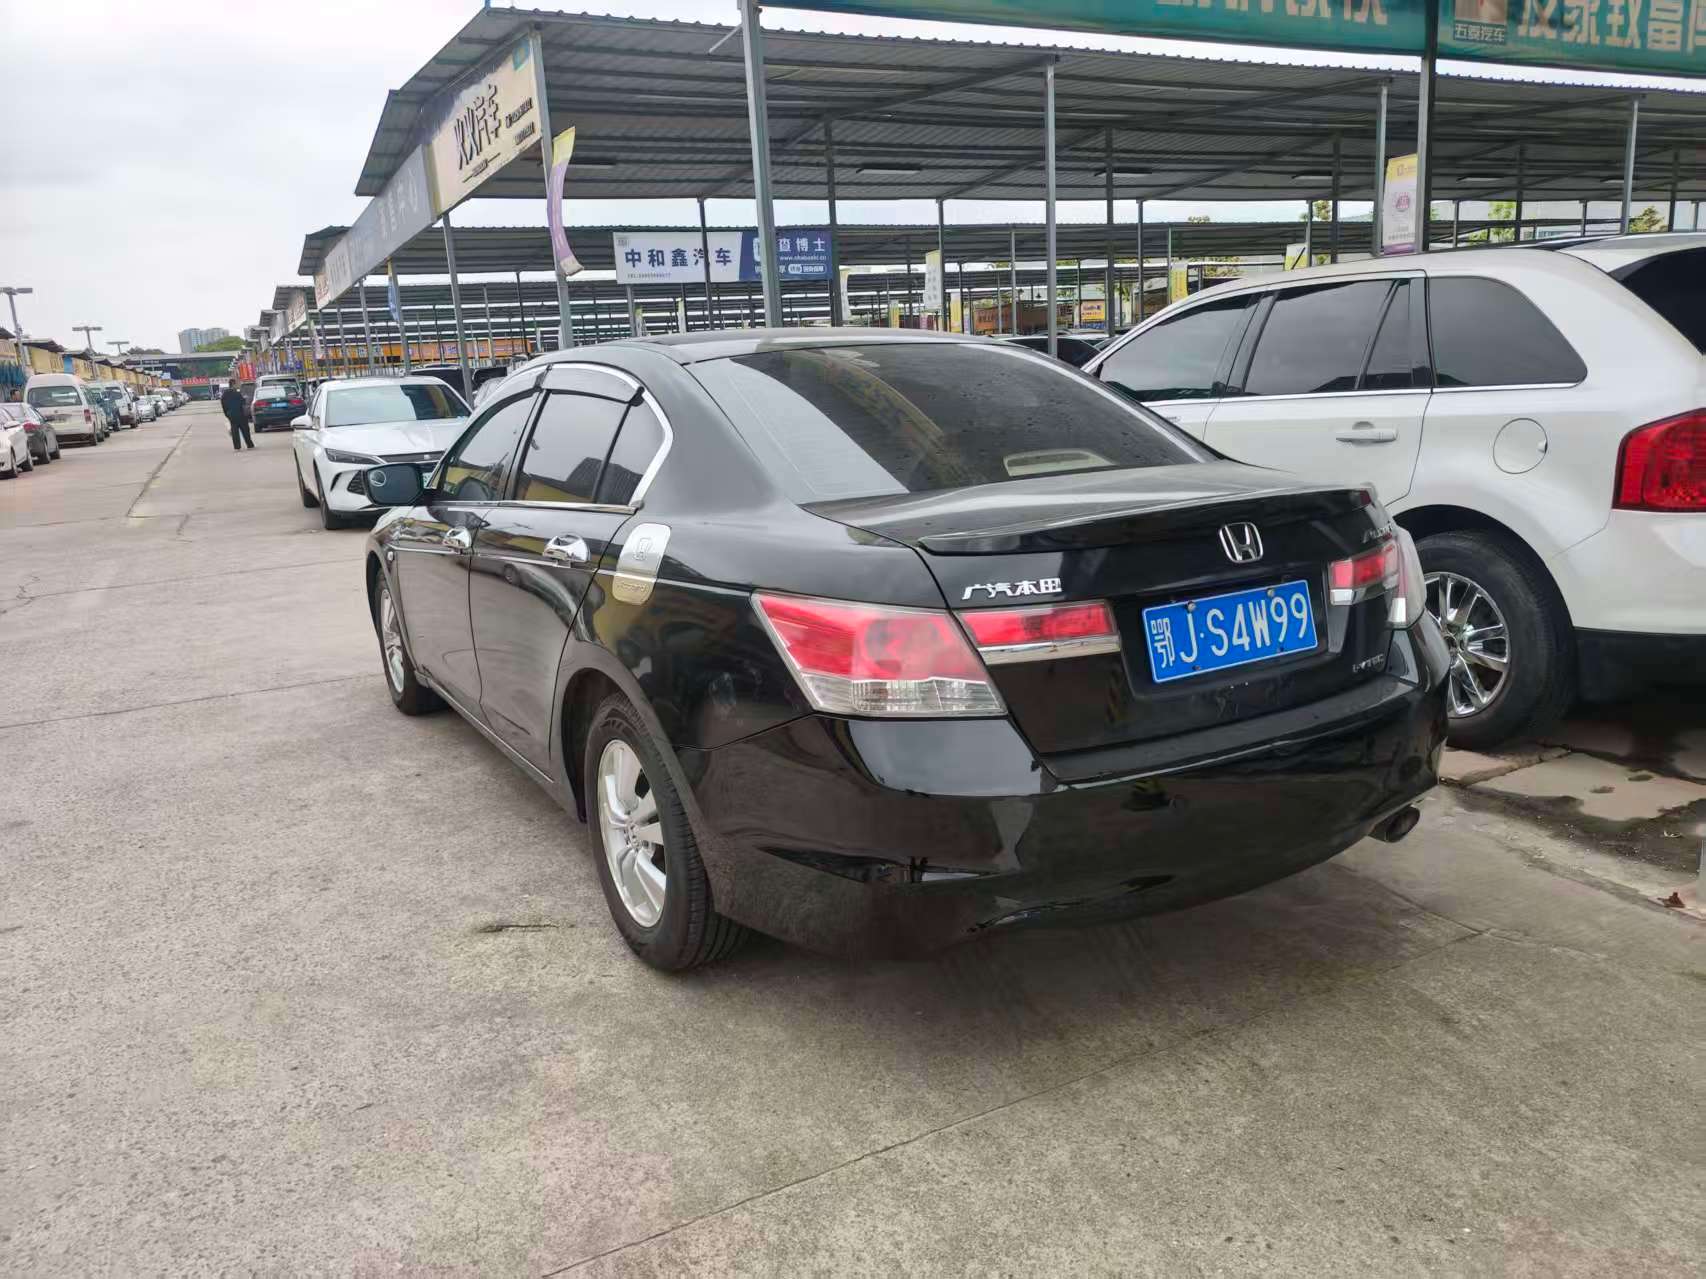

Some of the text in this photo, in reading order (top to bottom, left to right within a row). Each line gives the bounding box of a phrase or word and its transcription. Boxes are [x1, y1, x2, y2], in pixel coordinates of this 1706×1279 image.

[624, 248, 732, 268] 中和鑫汽车
[962, 577, 1062, 600] 广汽本田
